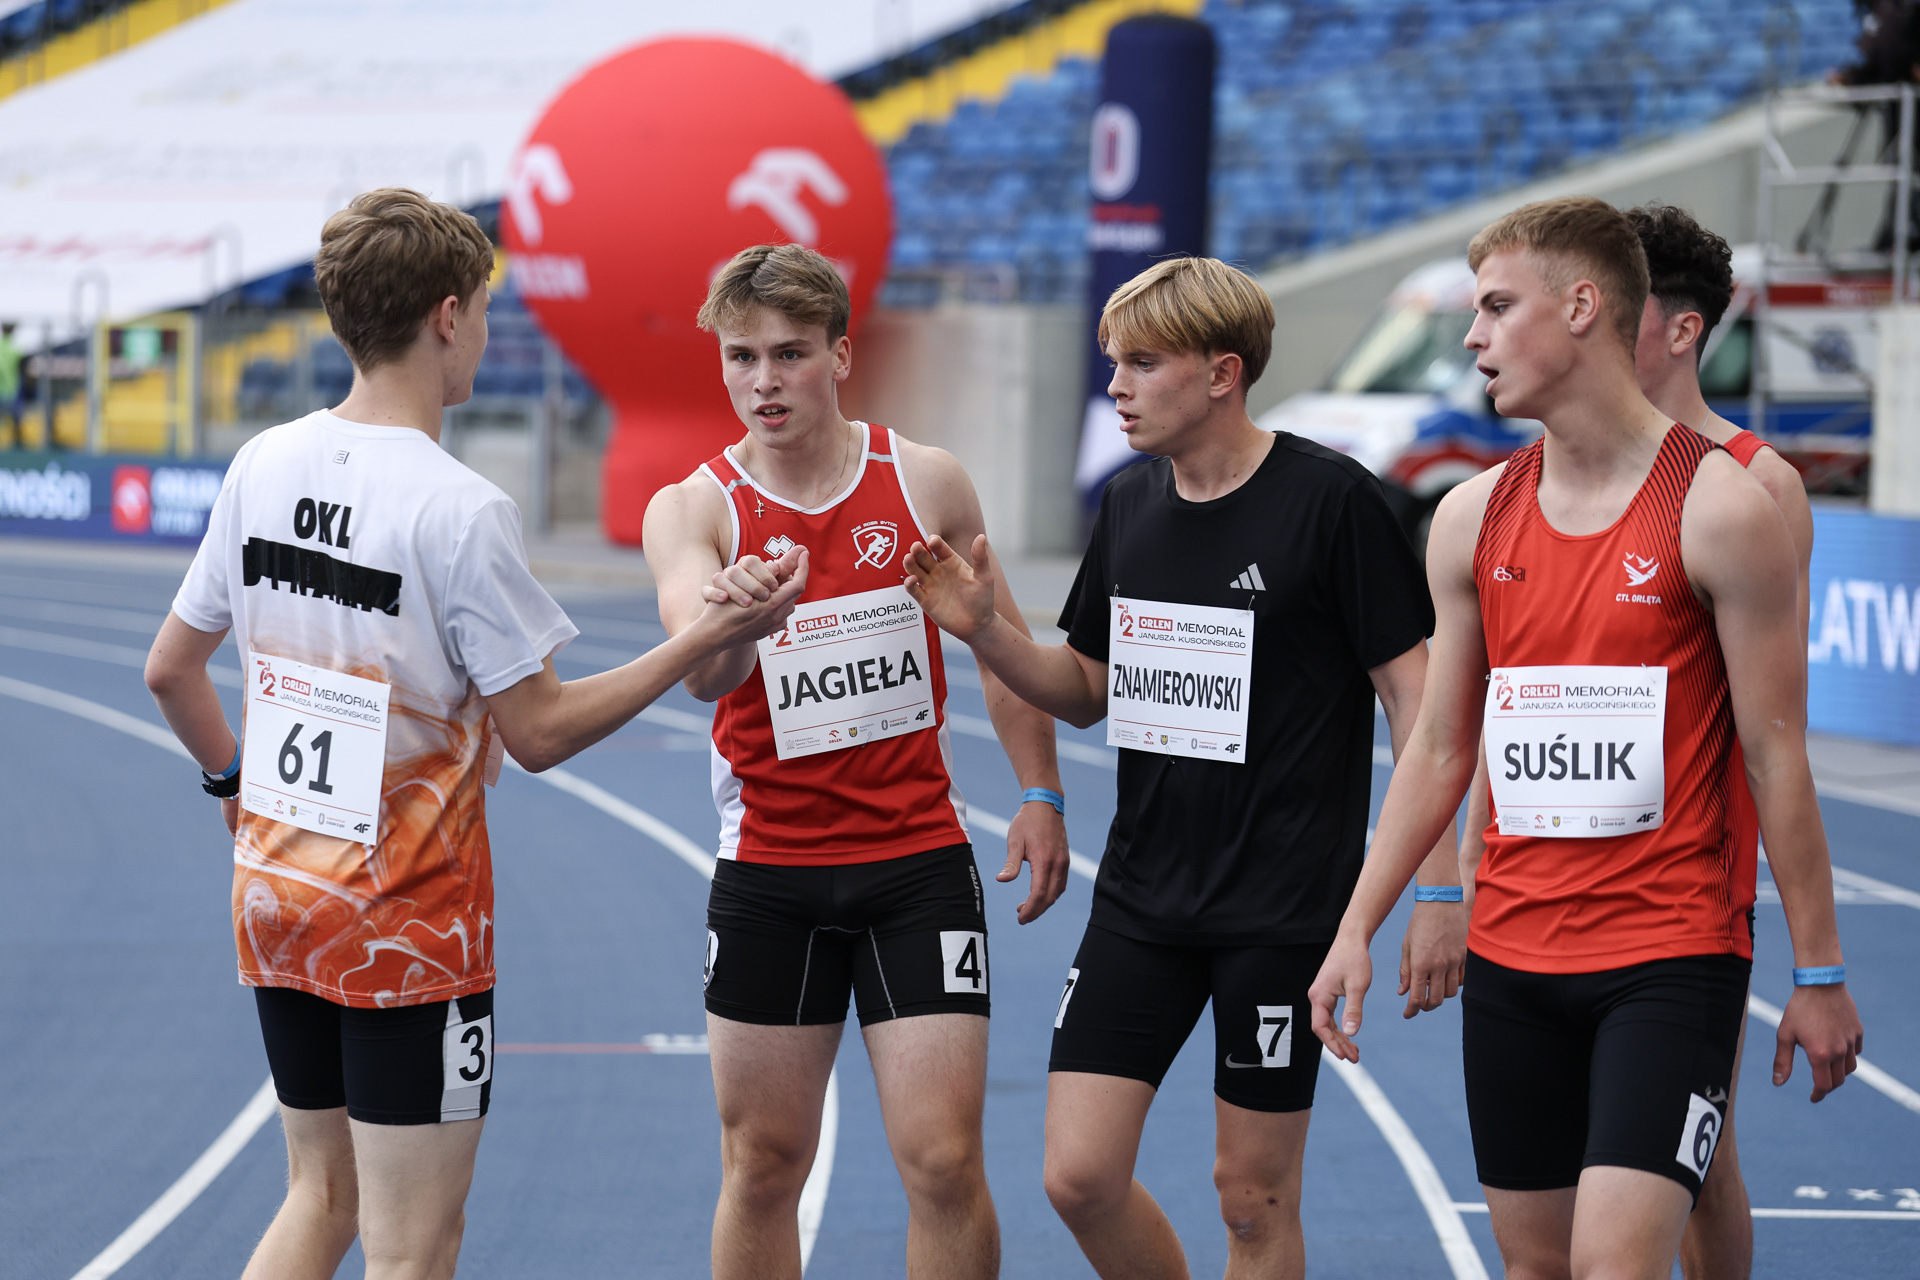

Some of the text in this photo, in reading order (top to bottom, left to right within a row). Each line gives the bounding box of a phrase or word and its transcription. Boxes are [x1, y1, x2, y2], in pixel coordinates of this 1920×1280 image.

[294, 497, 352, 549] OKL
[1615, 593, 1662, 606] CTL ORLĘTA
[797, 601, 916, 632] ORLEN MEMORIAŁ
[798, 613, 918, 643] JANUSZA KUSOCIŃSKIEGO
[1139, 617, 1246, 638] ORLEN MEMORIAŁ
[1138, 632, 1247, 649] JANUSZA KUSOCIŃSKIEGO
[282, 676, 381, 712] ORLEN MEMORIAŁ
[778, 650, 922, 710] JAGIEŁA
[1113, 663, 1241, 712] ZNAMIEROWSKI
[1521, 685, 1655, 698] ORLEN MEMORIAŁ
[280, 692, 381, 724] JANUSZA KUSOCIŃSKIEGO
[915, 709, 929, 721] 4F
[1519, 700, 1656, 710] JANUSZA KUSOCIŃSKIEGO
[278, 722, 333, 795] 61
[1225, 743, 1241, 753] 4F
[1504, 733, 1637, 781] SUŚLIK
[353, 823, 371, 834] 4F
[1636, 811, 1657, 823] 4F
[955, 937, 982, 989] 4
[1262, 1016, 1290, 1057] 7
[459, 1025, 485, 1081] 3
[1693, 1111, 1716, 1171] 6
